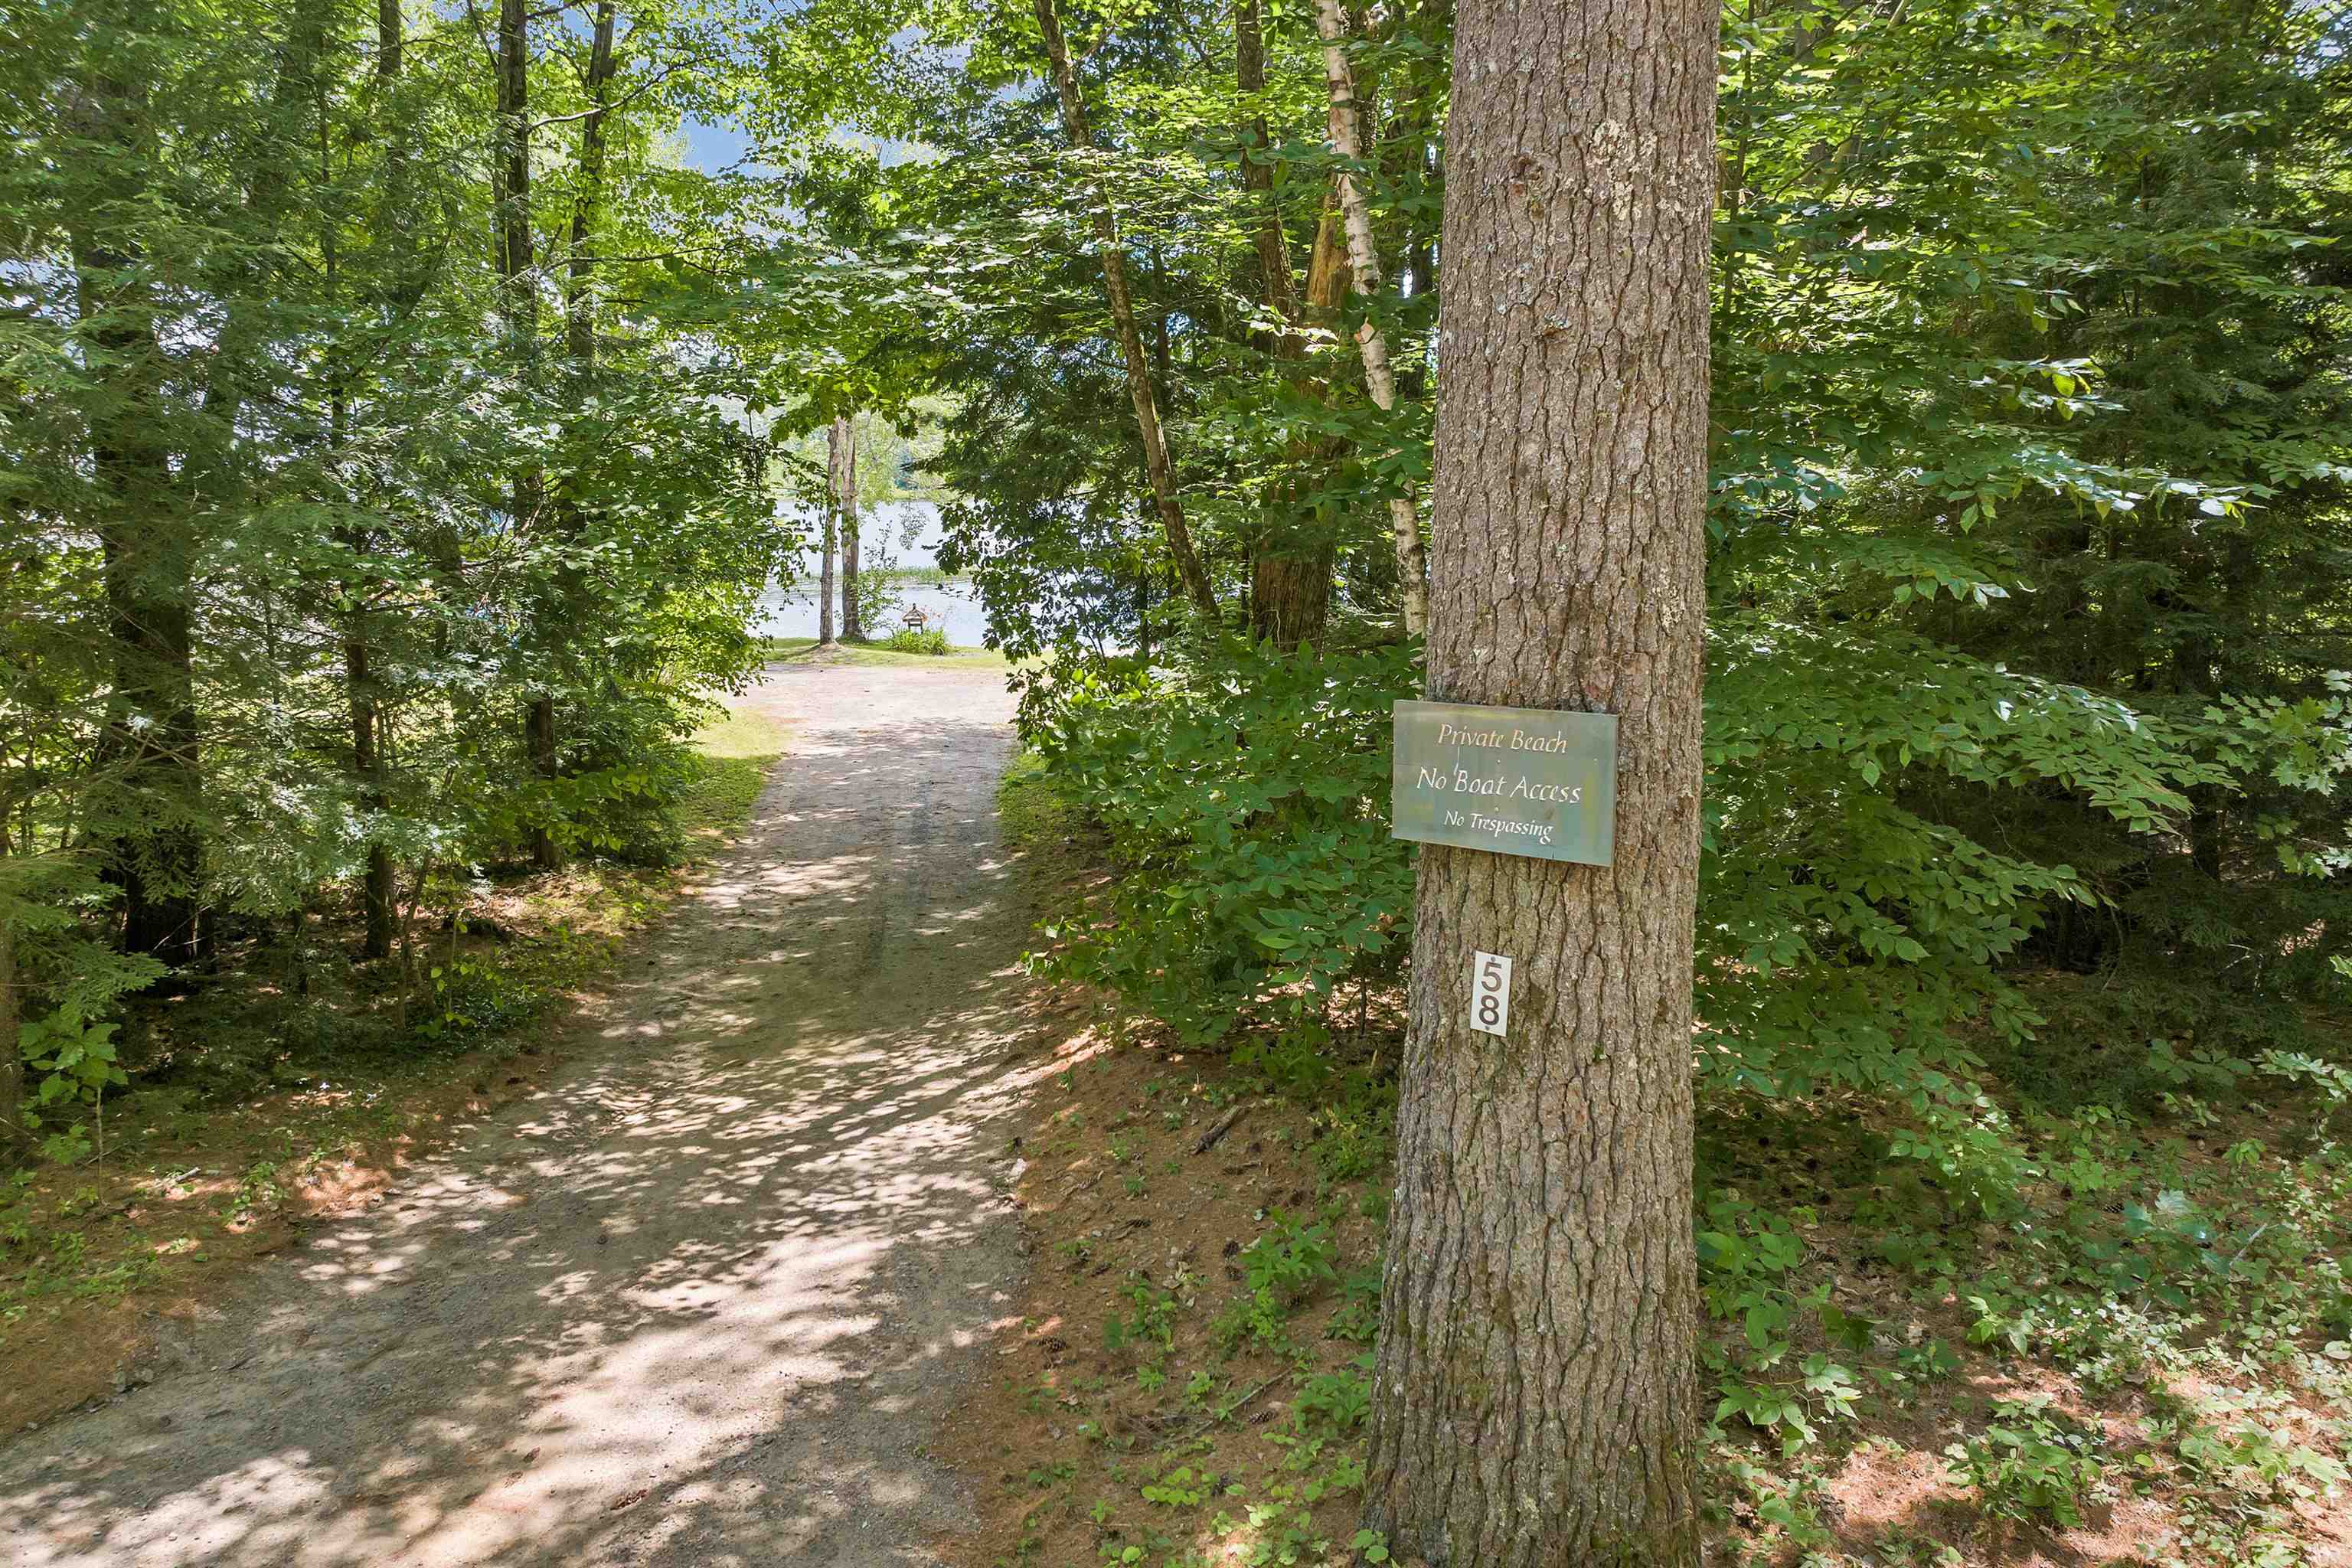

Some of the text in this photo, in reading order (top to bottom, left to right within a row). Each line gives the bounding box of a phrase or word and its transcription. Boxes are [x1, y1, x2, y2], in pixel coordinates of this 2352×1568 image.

[1438, 723, 1568, 754] Private Beach
[1416, 766, 1582, 803] No Boat Access
[1445, 811, 1554, 845] No Trespassing
[1478, 961, 1502, 1026] 58
